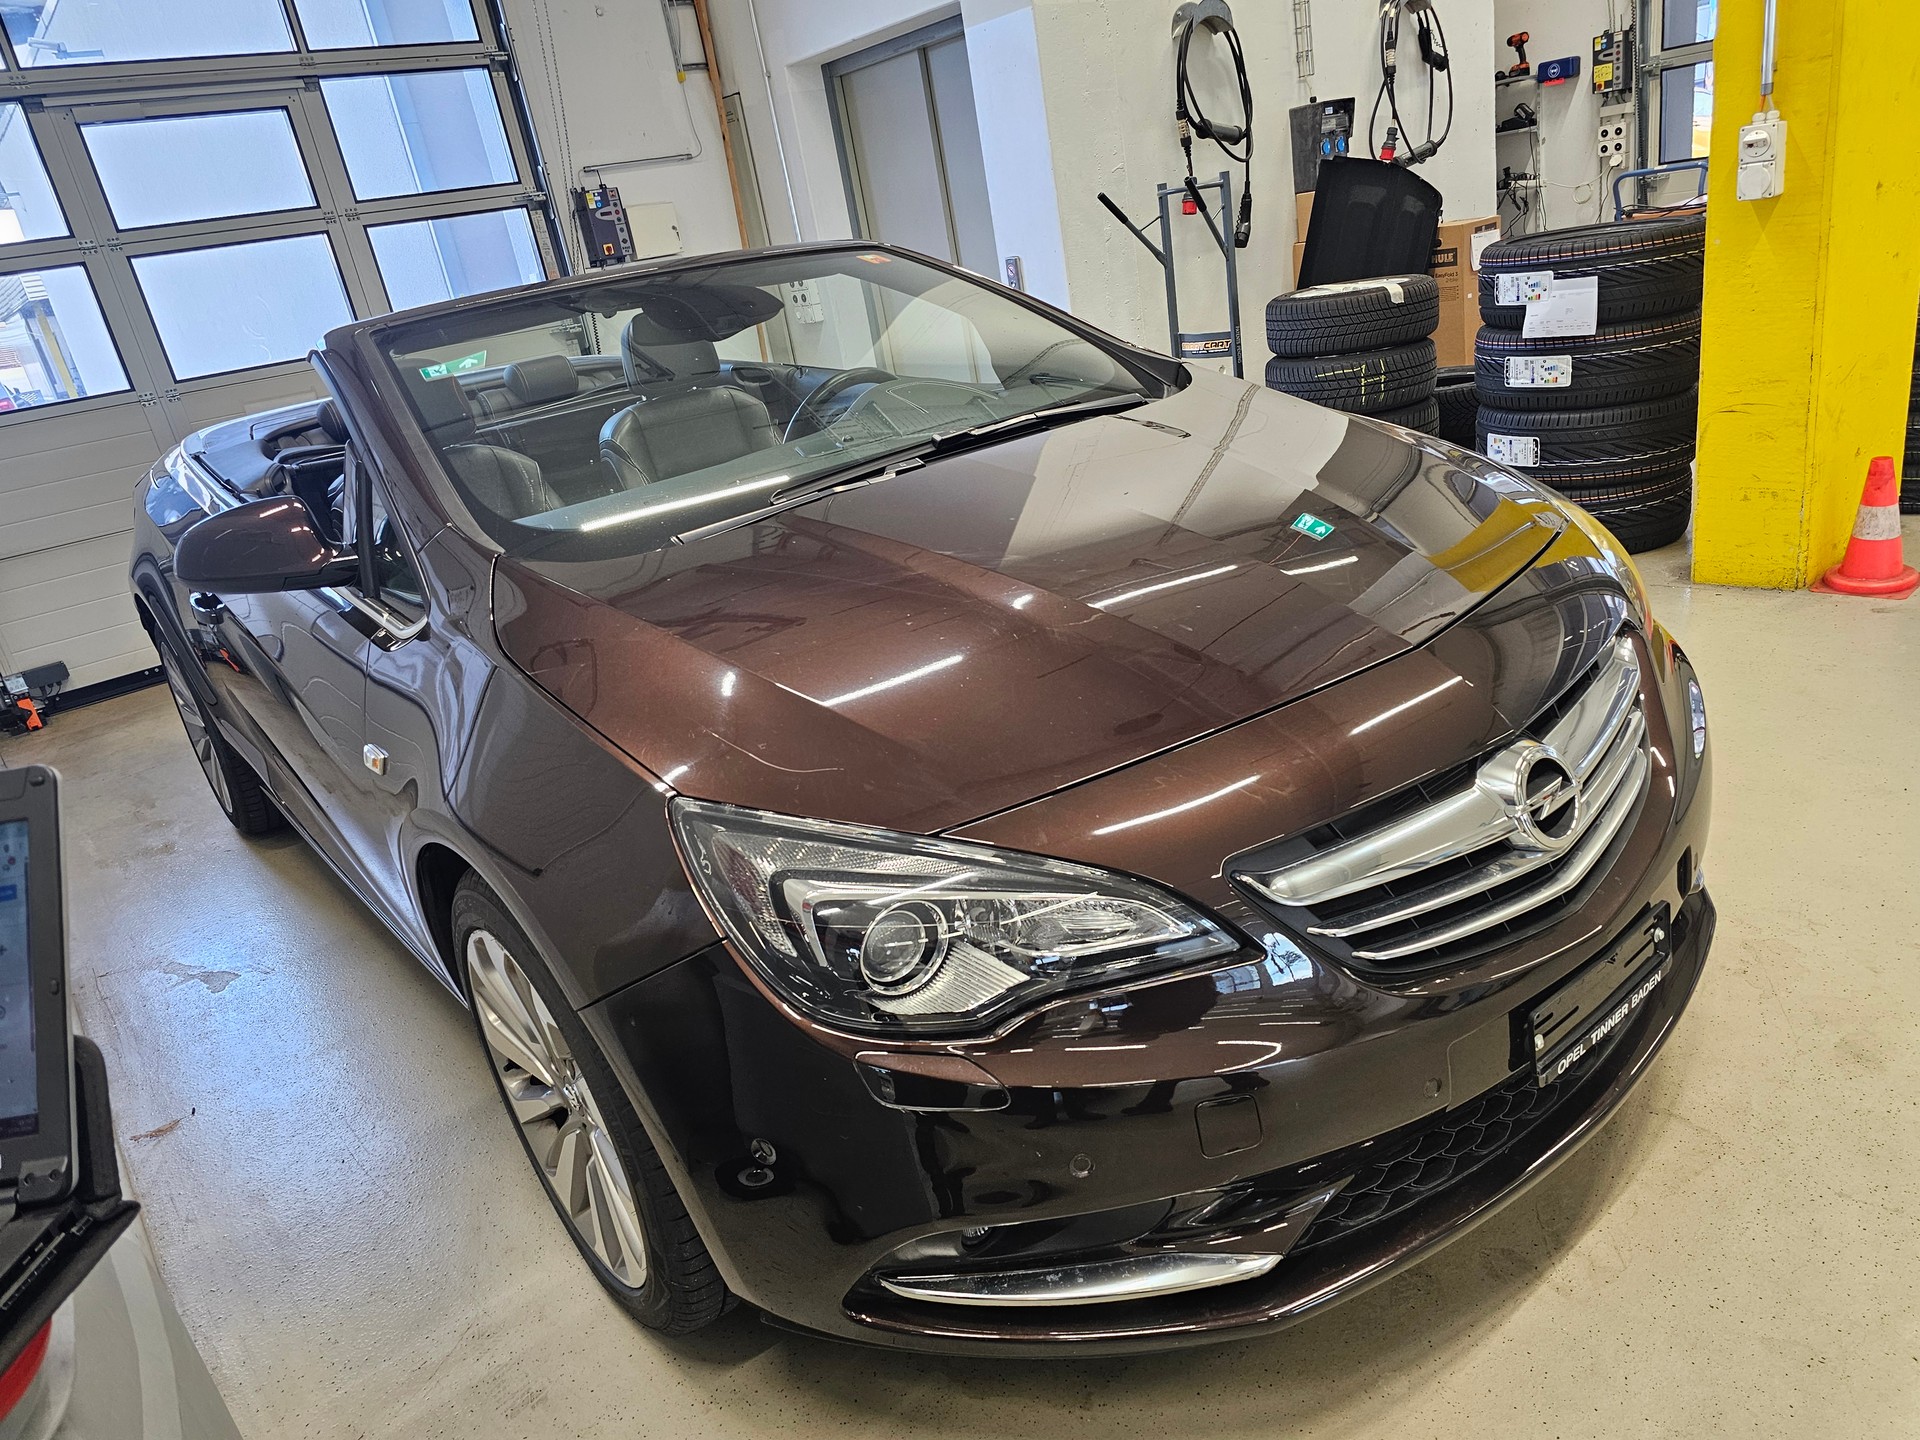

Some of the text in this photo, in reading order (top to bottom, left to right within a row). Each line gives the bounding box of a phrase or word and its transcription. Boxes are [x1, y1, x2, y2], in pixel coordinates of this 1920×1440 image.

[1431, 253, 1454, 263] HULE
[1557, 970, 1662, 1075] OPEL TINNER BADEN
